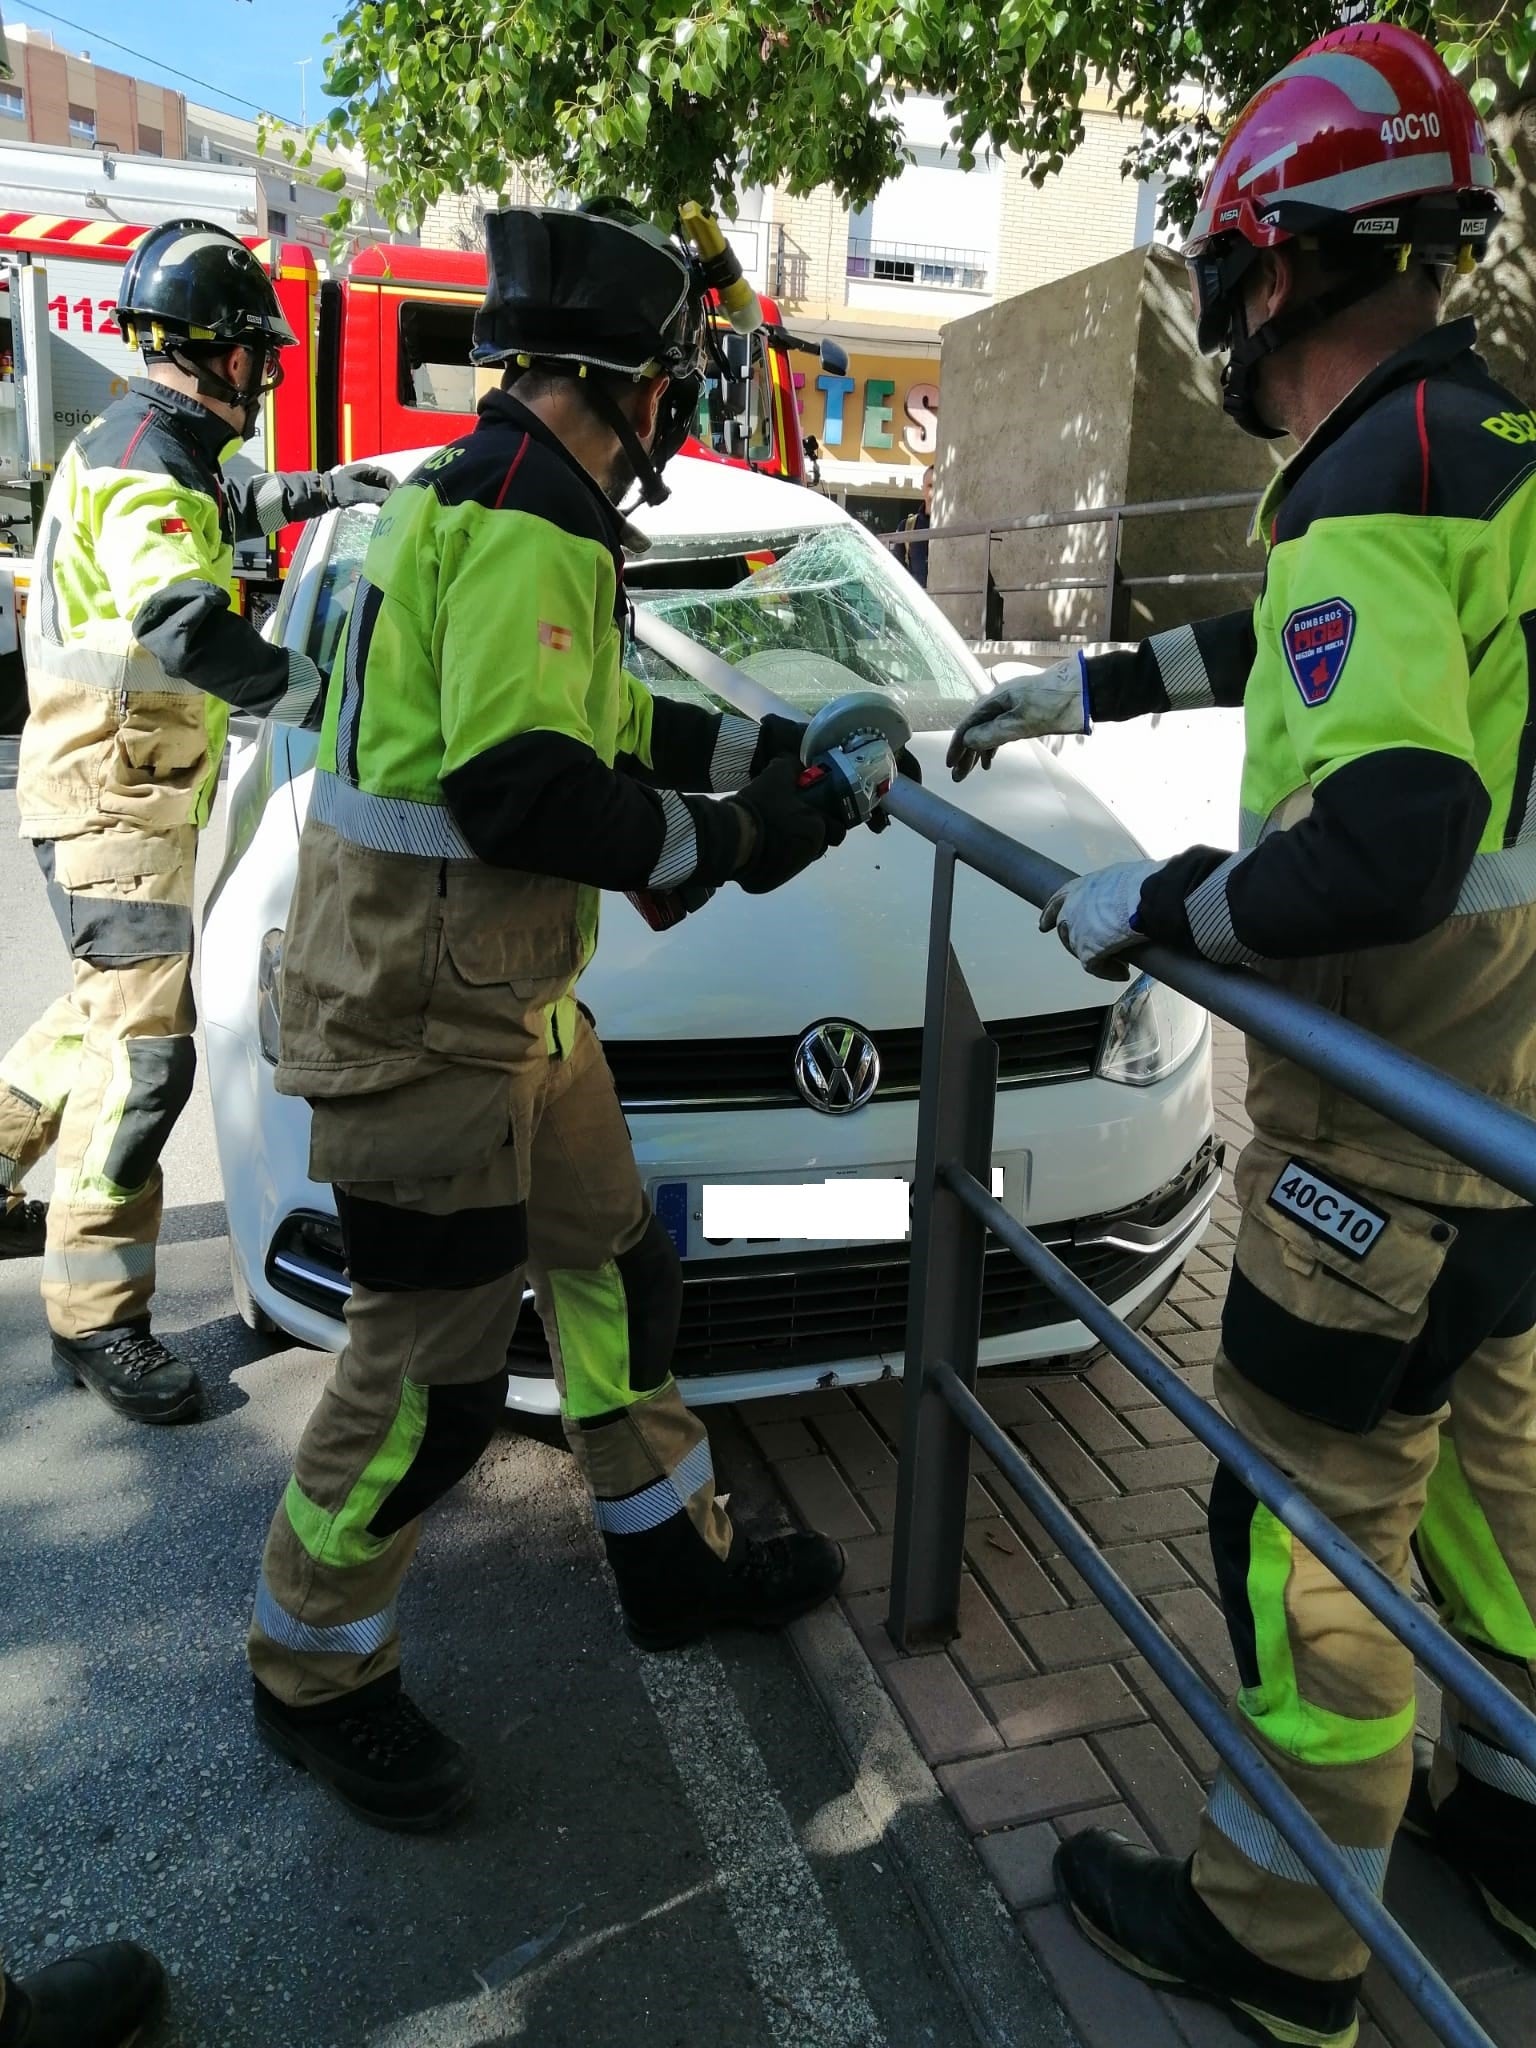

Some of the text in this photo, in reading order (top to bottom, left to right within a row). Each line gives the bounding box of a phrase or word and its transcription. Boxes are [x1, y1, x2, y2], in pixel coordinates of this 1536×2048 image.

[1381, 112, 1440, 144] 40C10
[1355, 218, 1397, 233] MSA
[49, 295, 121, 335] 112
[54, 409, 99, 427] egió
[1294, 609, 1342, 632] BOMBEROS
[1280, 1177, 1373, 1243] 40C10
